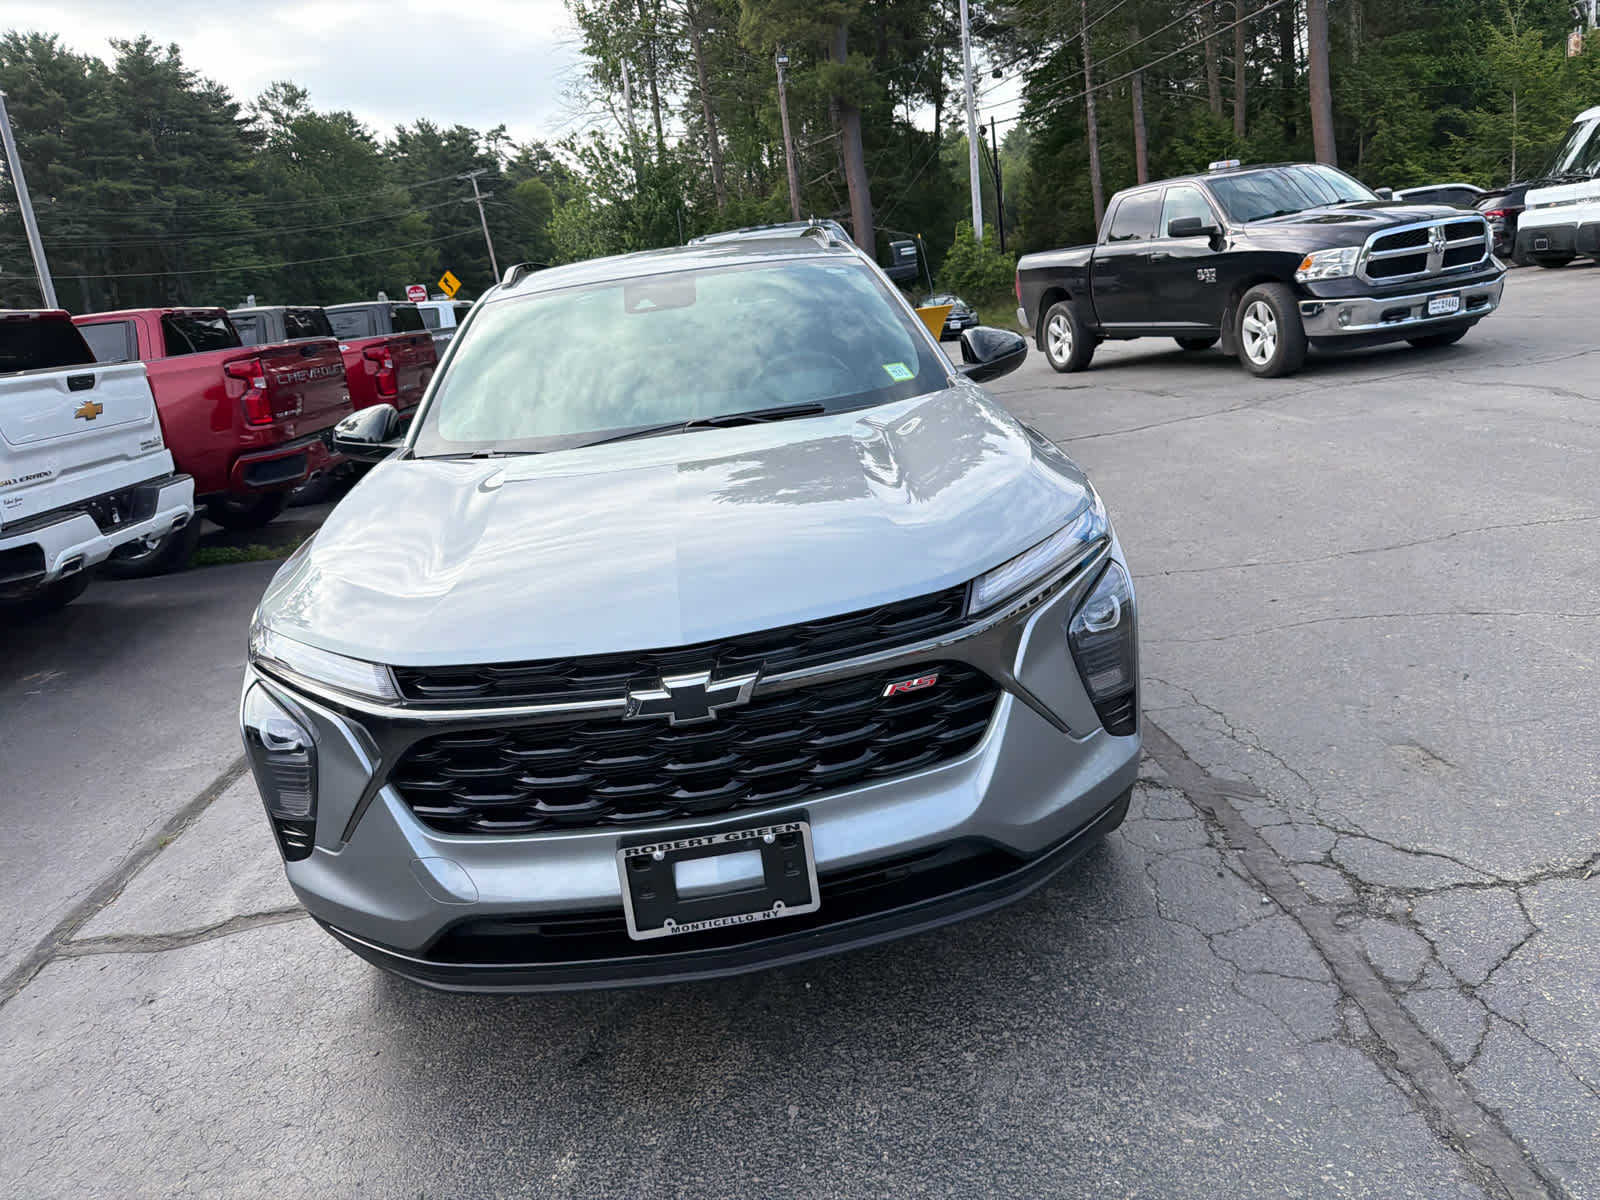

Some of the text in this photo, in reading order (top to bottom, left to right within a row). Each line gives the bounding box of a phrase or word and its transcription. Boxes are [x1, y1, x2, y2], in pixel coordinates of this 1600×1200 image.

[277, 363, 346, 384] CHEVROLET
[882, 673, 938, 697] RS
[624, 823, 801, 857] ROBERT GREEN
[762, 910, 779, 919] NY
